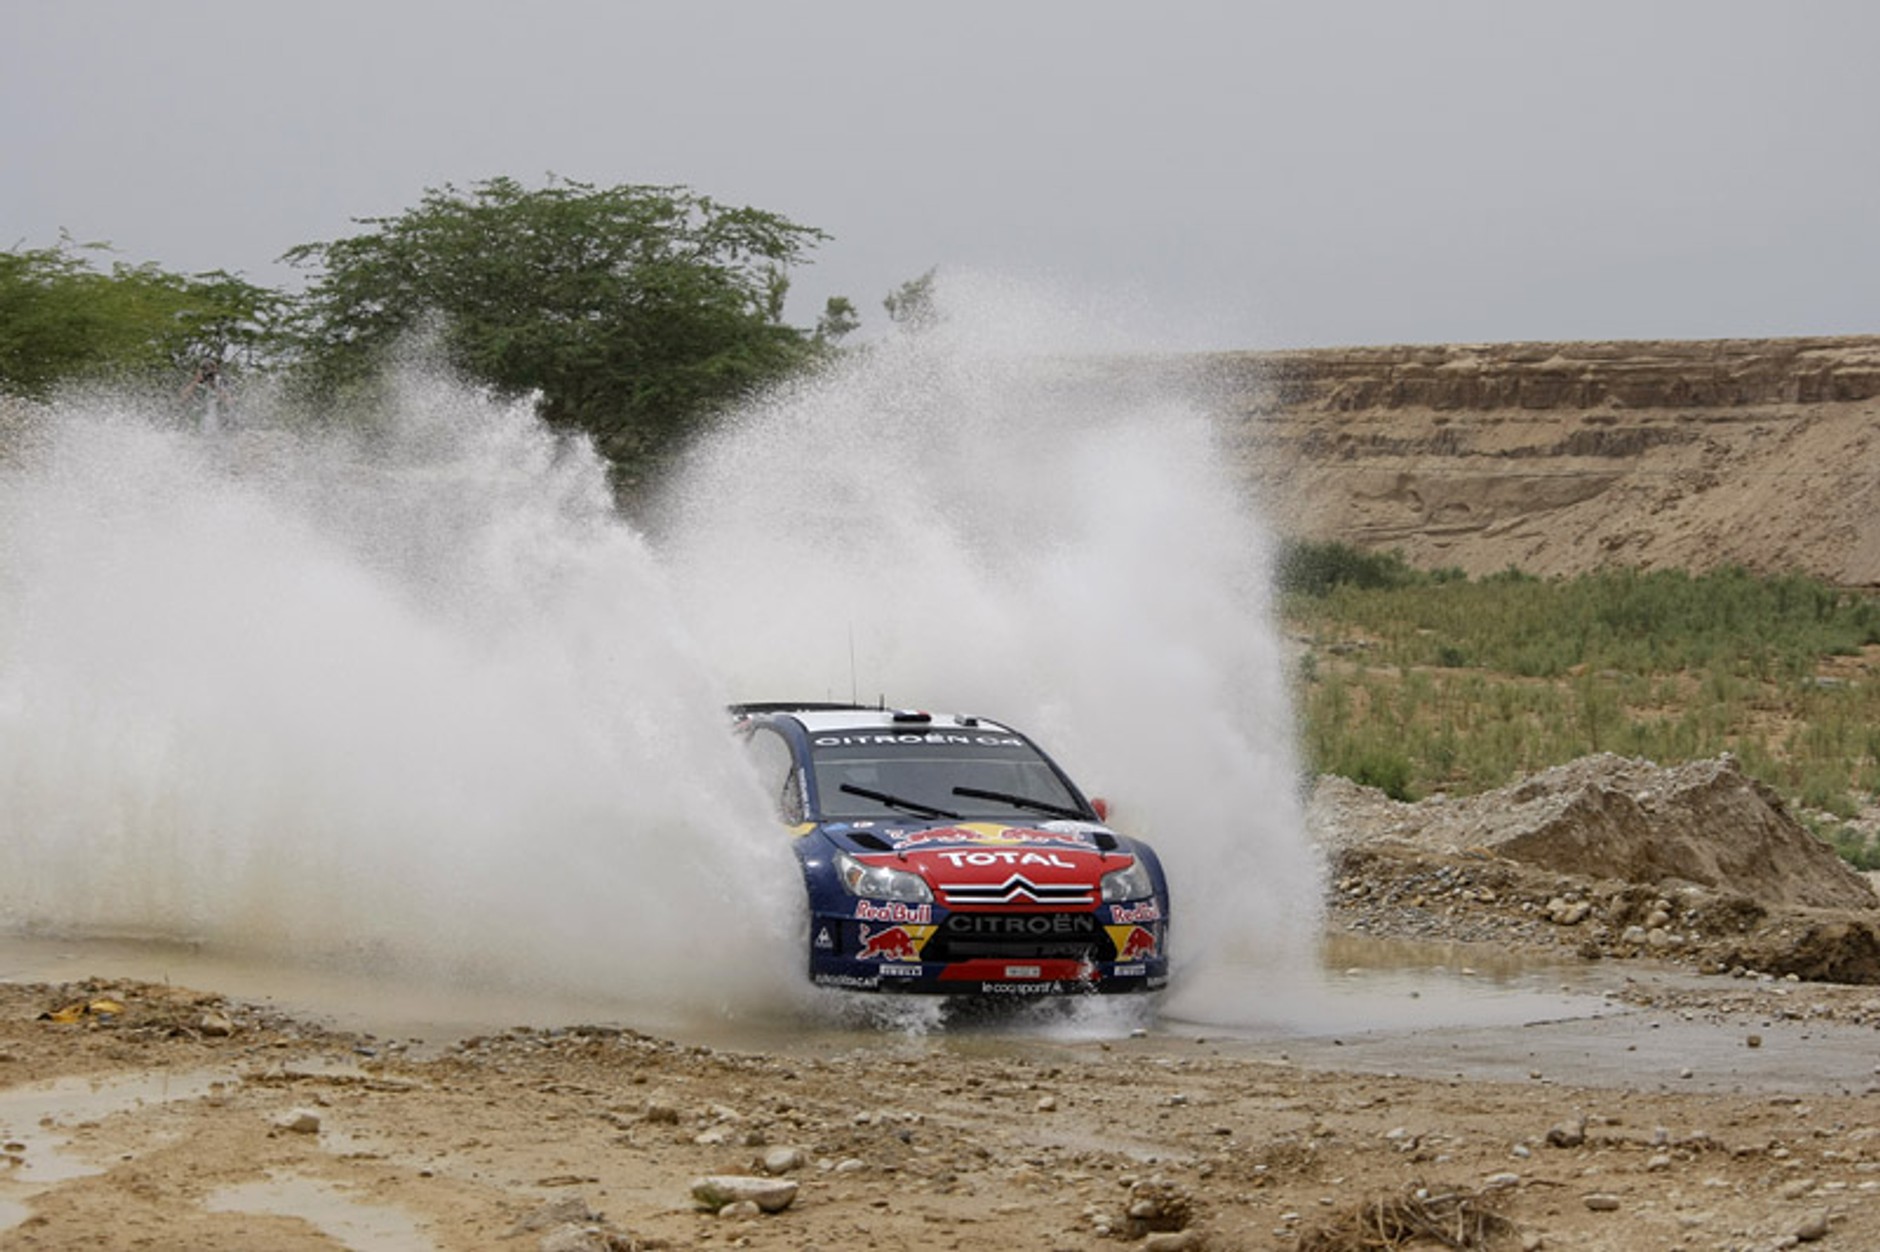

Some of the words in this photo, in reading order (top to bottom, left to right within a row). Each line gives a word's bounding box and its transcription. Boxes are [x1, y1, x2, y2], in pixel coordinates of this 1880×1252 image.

[939, 853, 1075, 868] TOTAL
[856, 900, 892, 921] Red
[891, 902, 932, 923] Bull
[949, 914, 1094, 933] CITROËN
